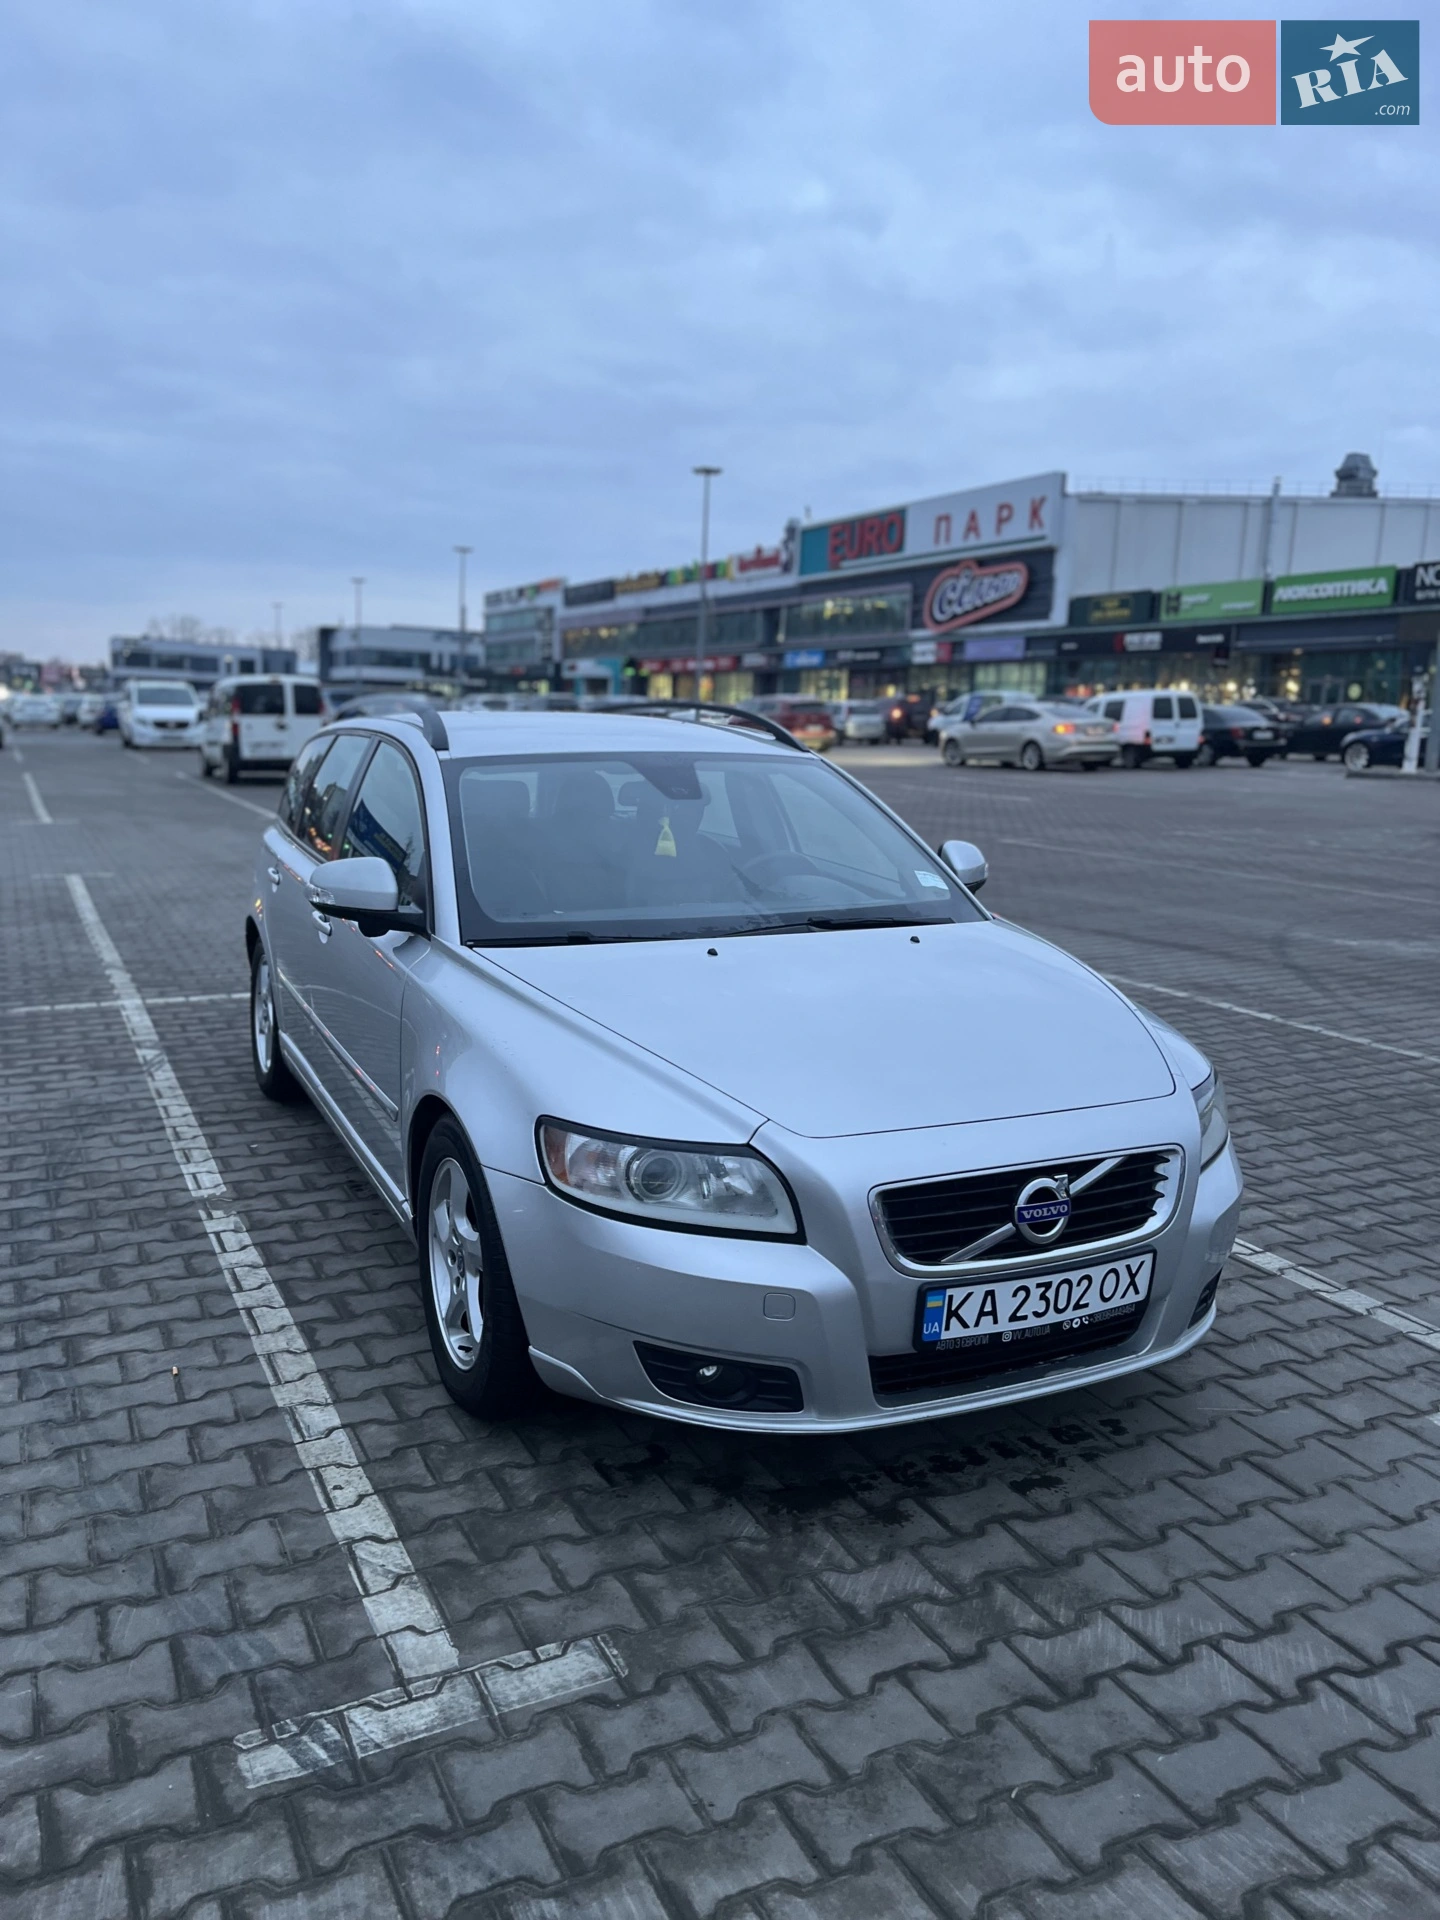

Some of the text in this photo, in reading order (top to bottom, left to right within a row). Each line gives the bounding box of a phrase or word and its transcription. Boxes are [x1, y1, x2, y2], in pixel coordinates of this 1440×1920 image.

[829, 512, 902, 568] EURO
[934, 497, 1046, 545] ПАРК
[1021, 1203, 1068, 1219] VOLVO
[944, 1260, 1145, 1332] KA 2302 OX
[923, 1321, 940, 1335] UA
